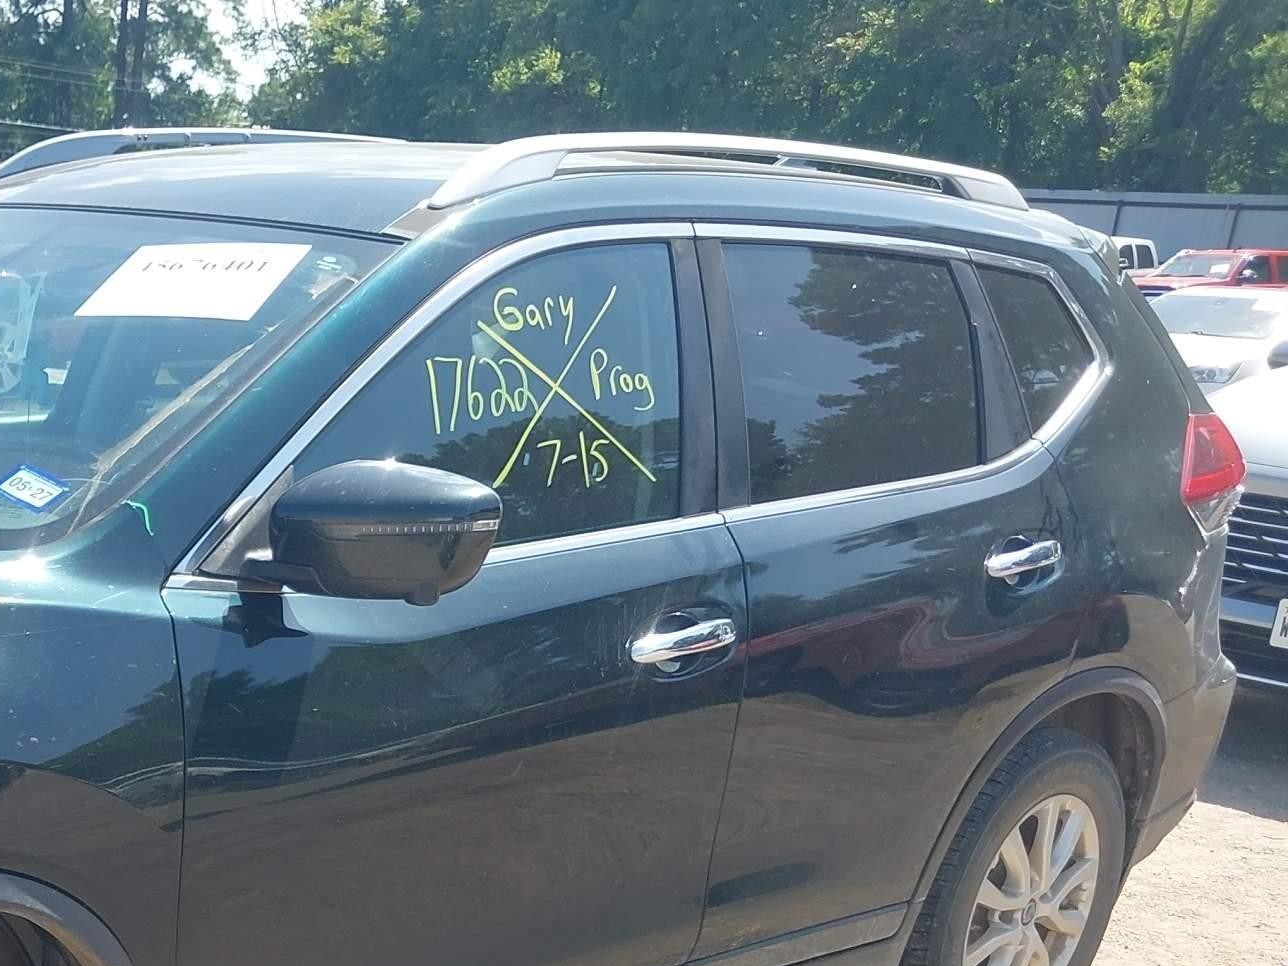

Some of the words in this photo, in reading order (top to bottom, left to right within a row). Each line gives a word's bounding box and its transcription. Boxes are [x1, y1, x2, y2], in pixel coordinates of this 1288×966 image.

[493, 287, 573, 345] Gary
[426, 355, 540, 434] 17622
[590, 348, 655, 411] Prog
[536, 430, 611, 488] 7-15
